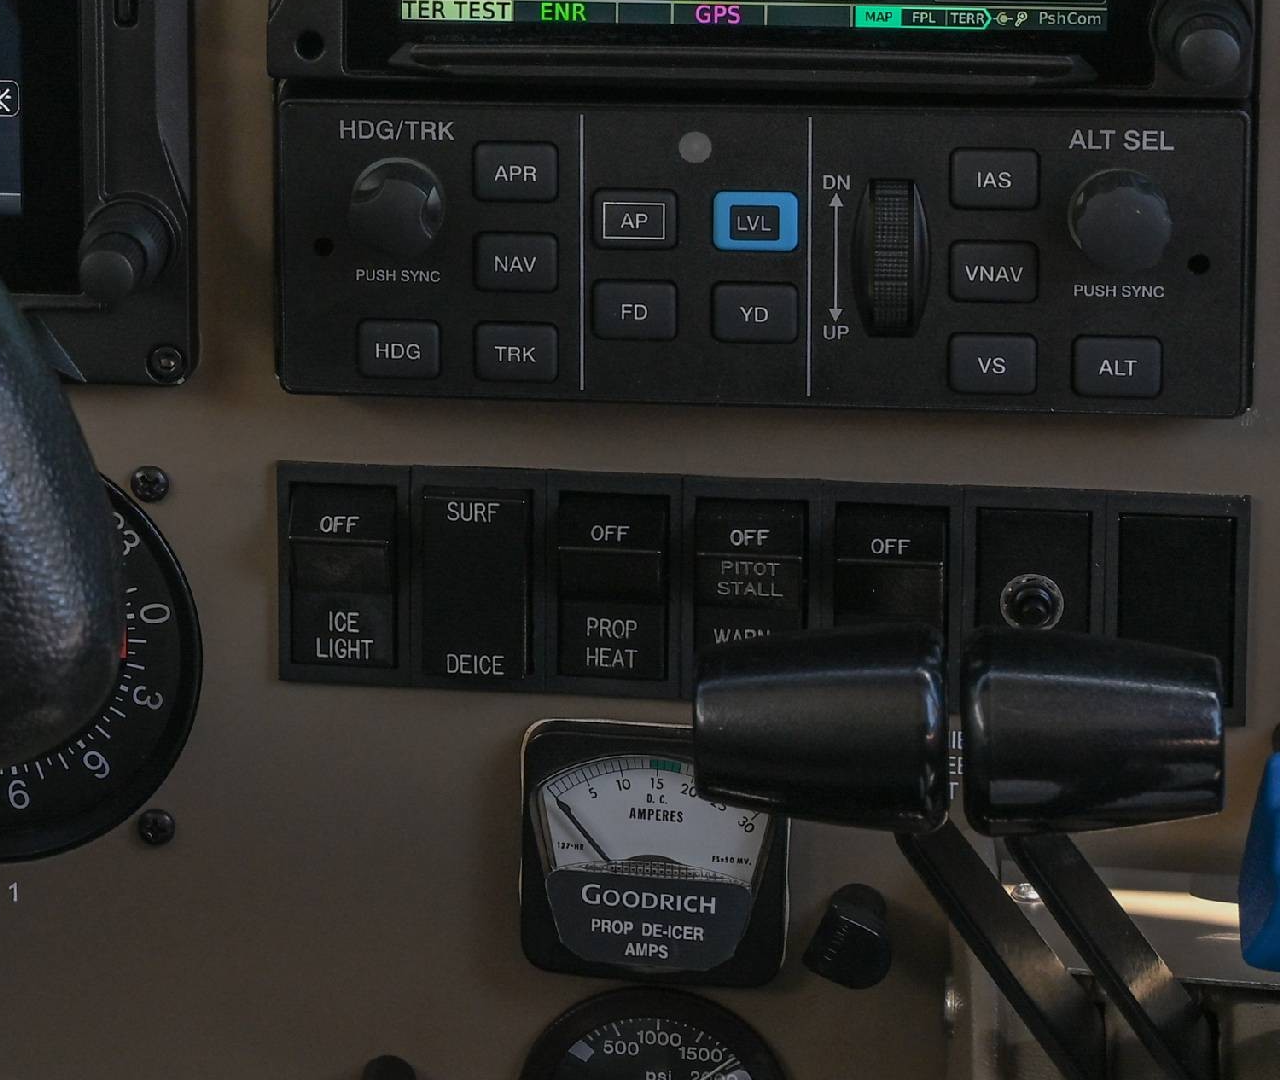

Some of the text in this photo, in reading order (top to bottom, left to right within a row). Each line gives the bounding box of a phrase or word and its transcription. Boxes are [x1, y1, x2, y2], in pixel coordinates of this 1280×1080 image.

[339, 120, 454, 141] HDG/TRK
[1069, 130, 1174, 151] ALT SEL
[494, 165, 537, 182] APR
[976, 171, 1012, 188] IAS
[823, 175, 851, 191] DN
[621, 213, 648, 229] AP
[737, 216, 772, 232] LVL
[494, 256, 537, 273] NAV
[356, 269, 440, 283] PUSH SYNC
[965, 265, 1024, 283] VNAV
[1073, 284, 1165, 299] PUSH SYNC
[621, 304, 648, 321] FD
[740, 307, 769, 323] YD
[823, 325, 850, 340] UP
[375, 343, 421, 360] HDG
[494, 346, 536, 363] TRK
[978, 357, 1006, 375] VS
[1099, 359, 1138, 377] ALT
[447, 501, 500, 523] SURF
[320, 516, 360, 534] OFF
[591, 525, 630, 542] OFF
[729, 529, 769, 547] OFF
[871, 538, 911, 557] OFF
[721, 560, 780, 578] PITOT
[717, 581, 783, 598] STALL
[329, 611, 360, 634] ICE
[586, 617, 637, 639] PROP
[316, 638, 373, 660] LIGHT
[446, 654, 504, 676] DEICE
[586, 648, 638, 669] HEAT
[629, 807, 684, 823] AMPERES
[8, 882, 19, 903] 1
[591, 919, 704, 942] PROP DE-ICER
[624, 943, 669, 959] AMPS
[637, 1030, 682, 1048] 1000
[679, 1046, 723, 1062] 1500
